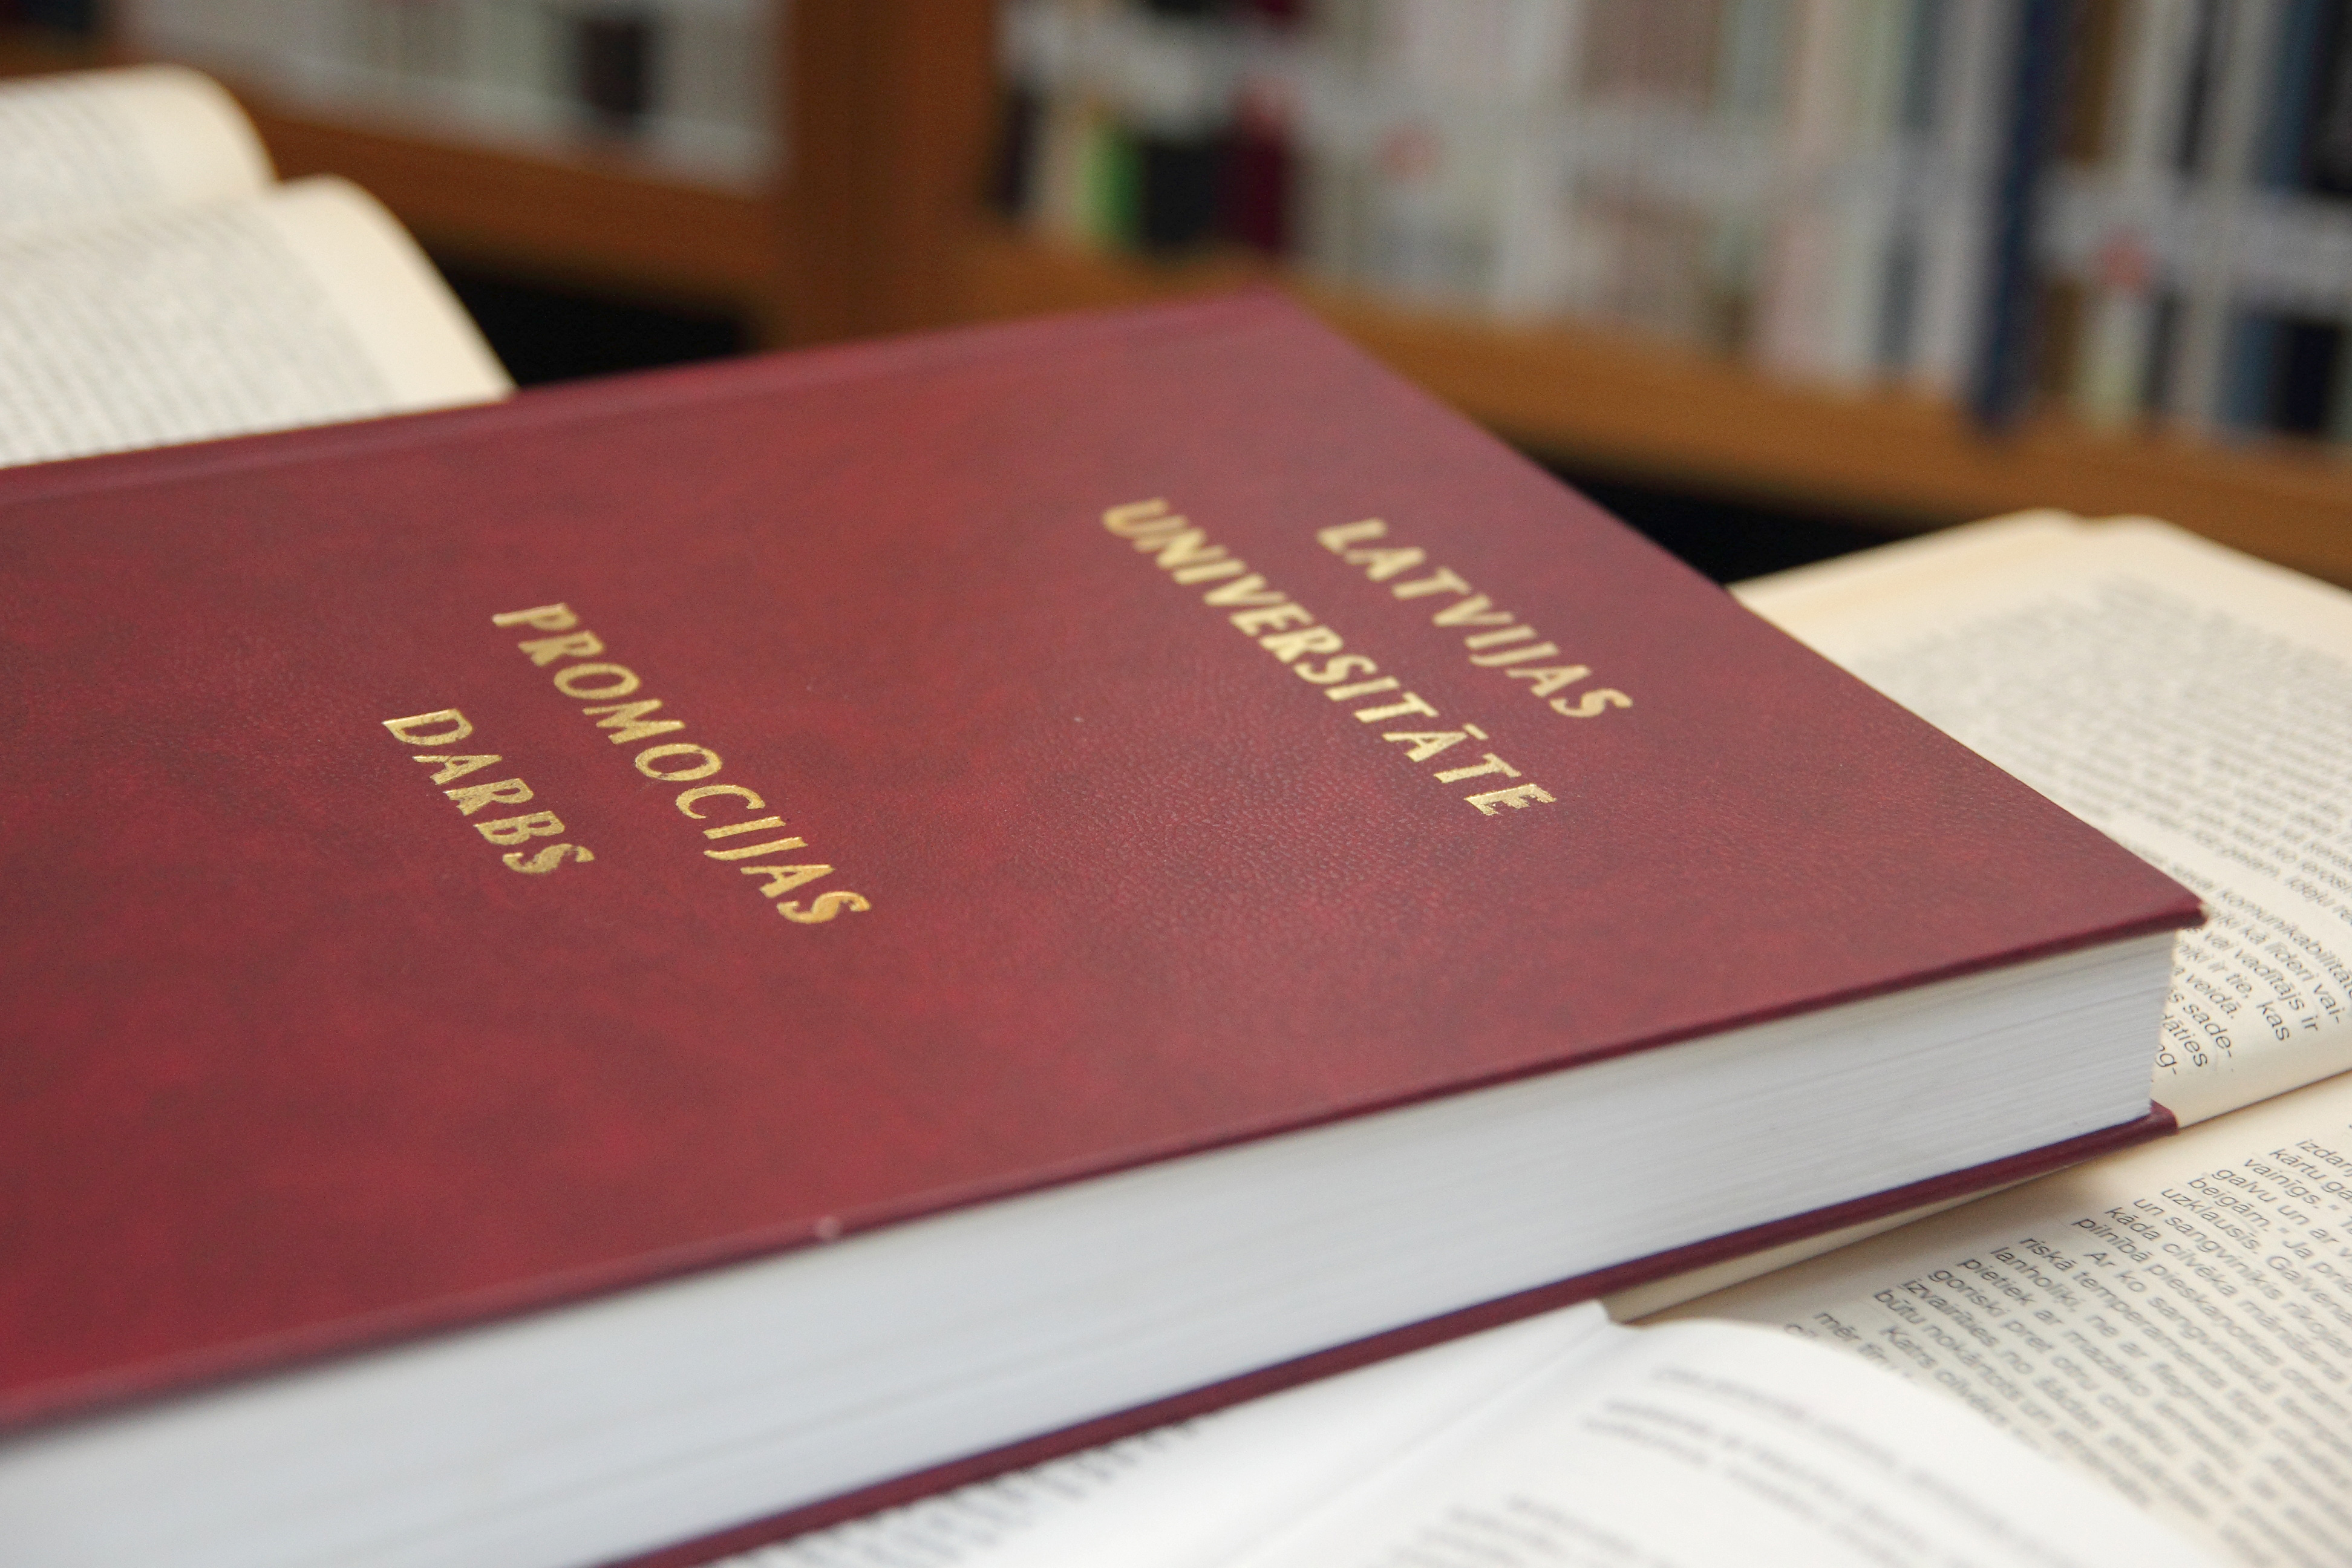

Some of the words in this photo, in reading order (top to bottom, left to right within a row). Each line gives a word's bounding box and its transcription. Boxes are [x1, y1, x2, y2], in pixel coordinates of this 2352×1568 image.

[1316, 518, 1633, 718] LATVIJAS
[1101, 498, 1557, 816] UNIVERSITĀTE
[382, 708, 595, 874] DARBS
[492, 603, 872, 924] PROMOCIJAS
[2185, 973, 2242, 1019] veidā.
[2203, 930, 2238, 951] vai
[2234, 948, 2305, 1011] vadītājs
[2301, 1014, 2319, 1031] ir
[2264, 941, 2319, 982] līderi
[2313, 982, 2346, 1024] vai-
[2182, 1003, 2232, 1058] sade-
[2256, 1000, 2290, 1042] kas
[2269, 1148, 2327, 1180] kārtu
[2071, 1218, 2155, 1264] pilnībā
[2161, 1188, 2261, 1255] uzklausīs.
[2211, 1169, 2279, 1203] galvu
[2276, 1204, 2311, 1226] un
[2309, 1228, 2341, 1243] ar
[2017, 1236, 2078, 1272] riskā
[2083, 1252, 2115, 1268] Ar
[2114, 1270, 2148, 1293] ko
[2104, 1206, 2162, 1241] kāda
[2161, 1242, 2239, 1298] cilvēka
[2133, 1198, 2166, 1217] un
[2164, 1216, 2284, 1300] sangviniķis
[2281, 1240, 2314, 1259] Ja
[1873, 1288, 1929, 1325] būtu
[1900, 1277, 2002, 1348] izvairīties
[1927, 1269, 2013, 1319] goriski
[1998, 1317, 2056, 1354] pret
[1957, 1256, 2039, 1307] pietiek
[2033, 1305, 2064, 1327] ar
[1990, 1246, 2086, 1313] lanholiķi,
[2084, 1314, 2119, 1338] ne
[1878, 1324, 1938, 1371] Katrs
